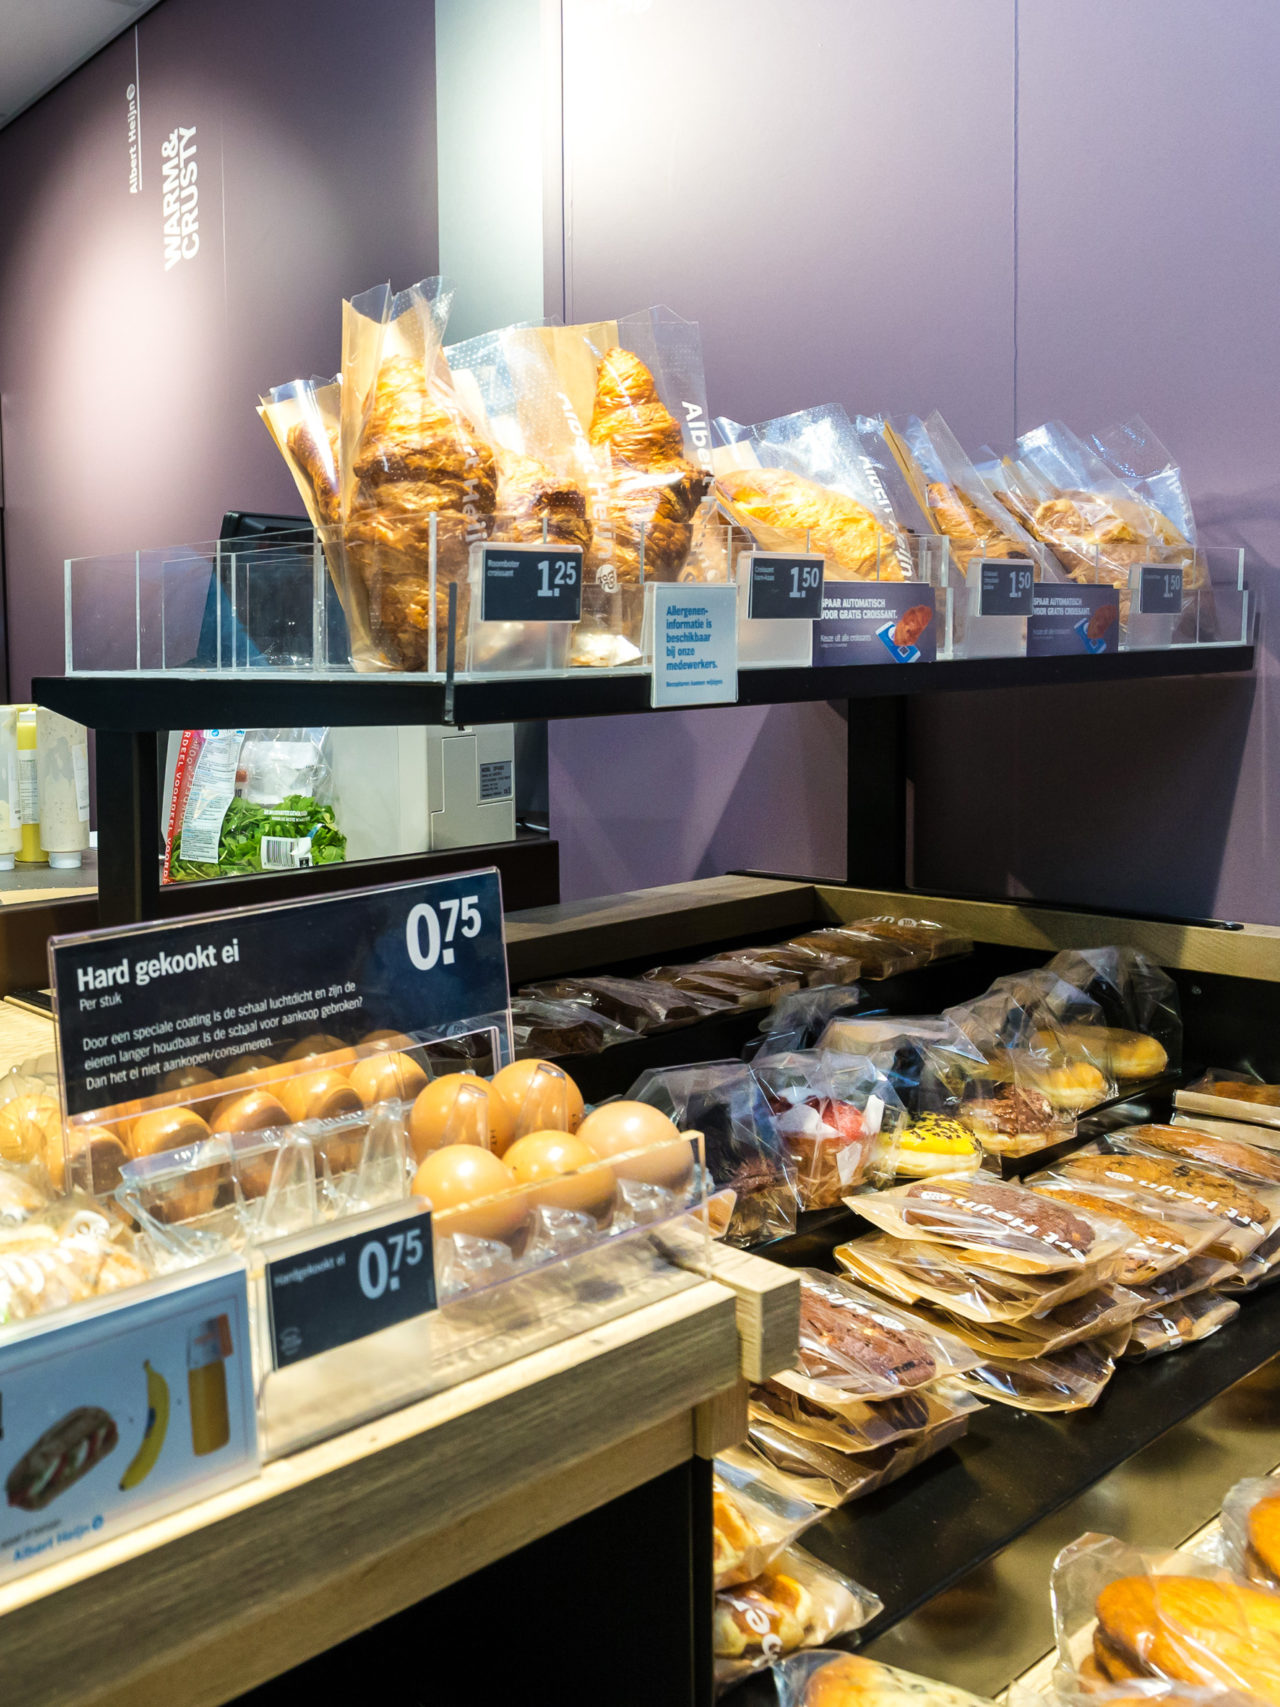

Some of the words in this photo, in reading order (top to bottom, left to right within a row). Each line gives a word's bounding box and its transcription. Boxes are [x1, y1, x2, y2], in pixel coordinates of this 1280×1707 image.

[127, 100, 137, 142] Heijn
[128, 145, 137, 194] Albert
[179, 126, 199, 260] CRUSTY
[537, 560, 577, 597] 1.25
[789, 566, 820, 598] 1.50
[1009, 571, 1031, 598] 1.50
[1163, 574, 1181, 598] 1.50
[666, 605, 709, 618] Allergenen-
[839, 609, 862, 619] GRATIS
[842, 598, 886, 609] AUTOMATISCH
[666, 619, 704, 630] informatie
[706, 618, 713, 629] is
[666, 632, 712, 643] beschikbaar
[666, 646, 676, 659] bij
[677, 647, 695, 656] onze
[666, 659, 718, 671] medewerkers.
[405, 895, 482, 971] 0.75
[76, 959, 130, 992] Hard
[135, 945, 217, 986] gekookt
[221, 938, 240, 963] ei
[79, 997, 96, 1012] Per
[100, 992, 123, 1007] stuk
[82, 1037, 108, 1051] Door
[111, 1031, 131, 1045] een
[133, 1021, 174, 1043] speciale
[175, 1013, 211, 1034] coating
[213, 1010, 222, 1022] is
[224, 1006, 236, 1020] de
[238, 999, 268, 1017] schaal
[269, 990, 313, 1010] luchtdicht
[315, 989, 326, 1000] en
[328, 984, 343, 1000] zijn
[344, 981, 356, 994] de
[84, 1055, 117, 1071] eieren
[119, 1045, 151, 1066] langer
[203, 1031, 212, 1043] Is
[214, 1028, 226, 1041] de
[228, 1021, 258, 1039] schaal
[259, 1018, 280, 1031] voor
[281, 1008, 319, 1029] aankoop
[321, 997, 363, 1019] gebroken?
[85, 1077, 108, 1091] Dan
[109, 1070, 127, 1084] het
[129, 1067, 139, 1080] ei
[141, 1062, 161, 1077] niet
[358, 1228, 424, 1299] 0.75
